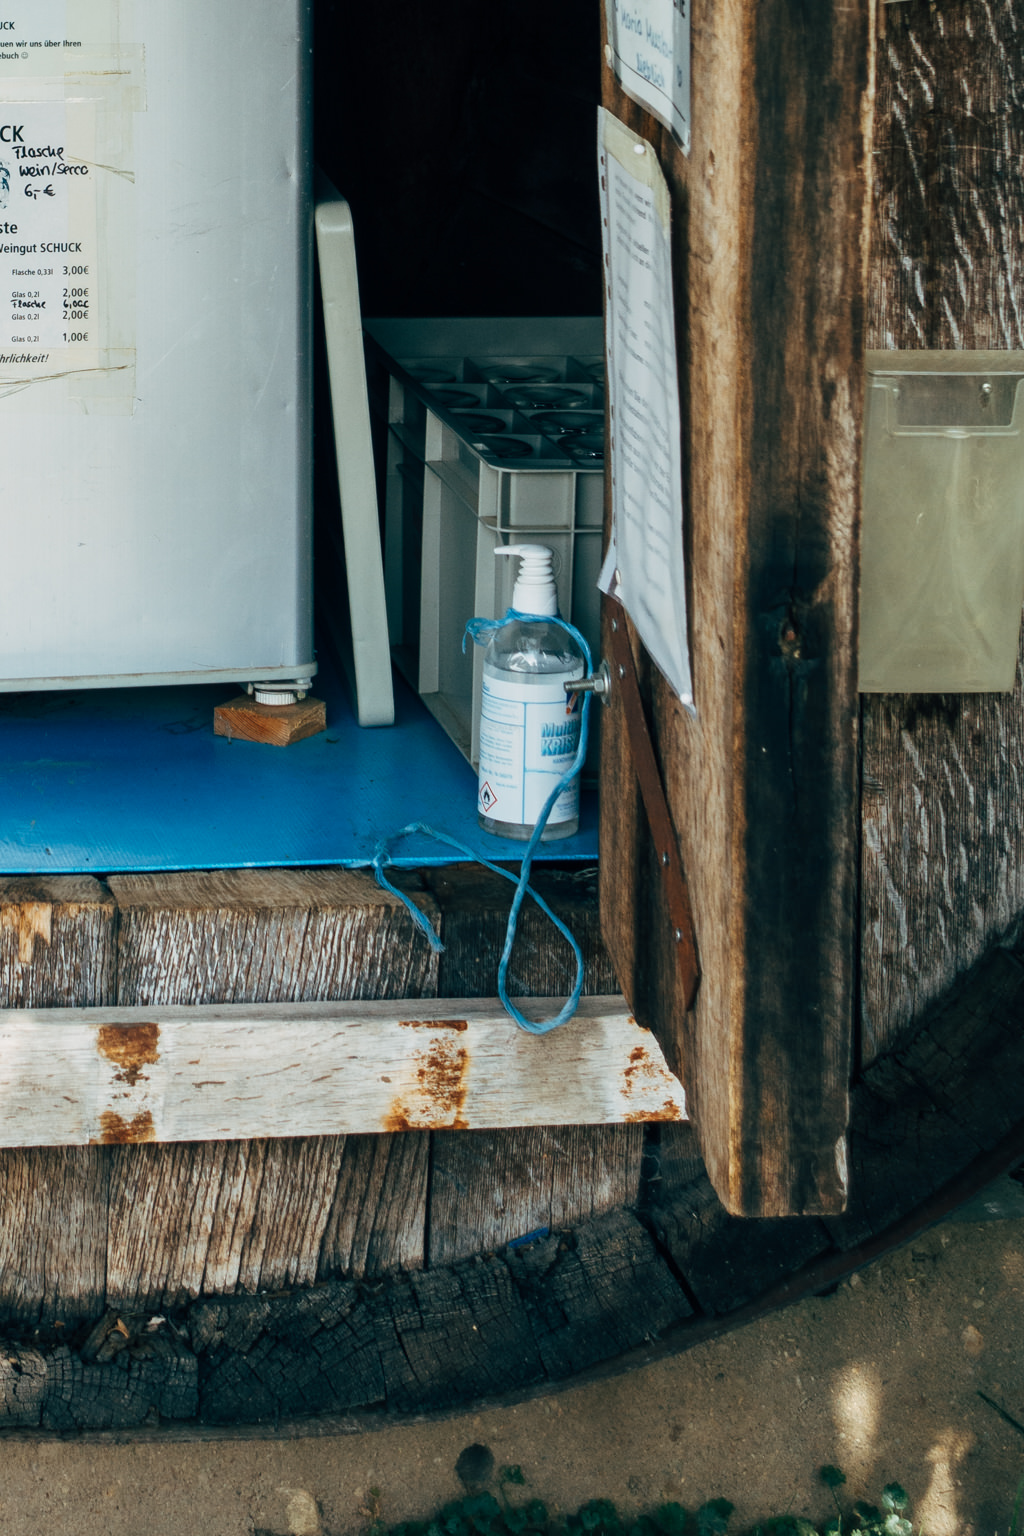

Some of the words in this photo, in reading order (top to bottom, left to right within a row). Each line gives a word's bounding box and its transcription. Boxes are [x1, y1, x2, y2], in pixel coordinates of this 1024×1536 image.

[12, 145, 64, 161] Flasche
[39, 242, 81, 252] SCHUCK
[36, 268, 53, 276] 0,33l
[62, 265, 88, 276] 3,00€
[11, 290, 25, 298] Glas
[27, 290, 39, 298] 0,2l
[62, 287, 88, 298] 2,00€
[11, 312, 25, 320] Glas
[26, 312, 39, 320] 0,2l
[62, 309, 88, 320] 2,00€
[26, 335, 39, 343] 0,2l
[62, 331, 88, 342] 1,00€
